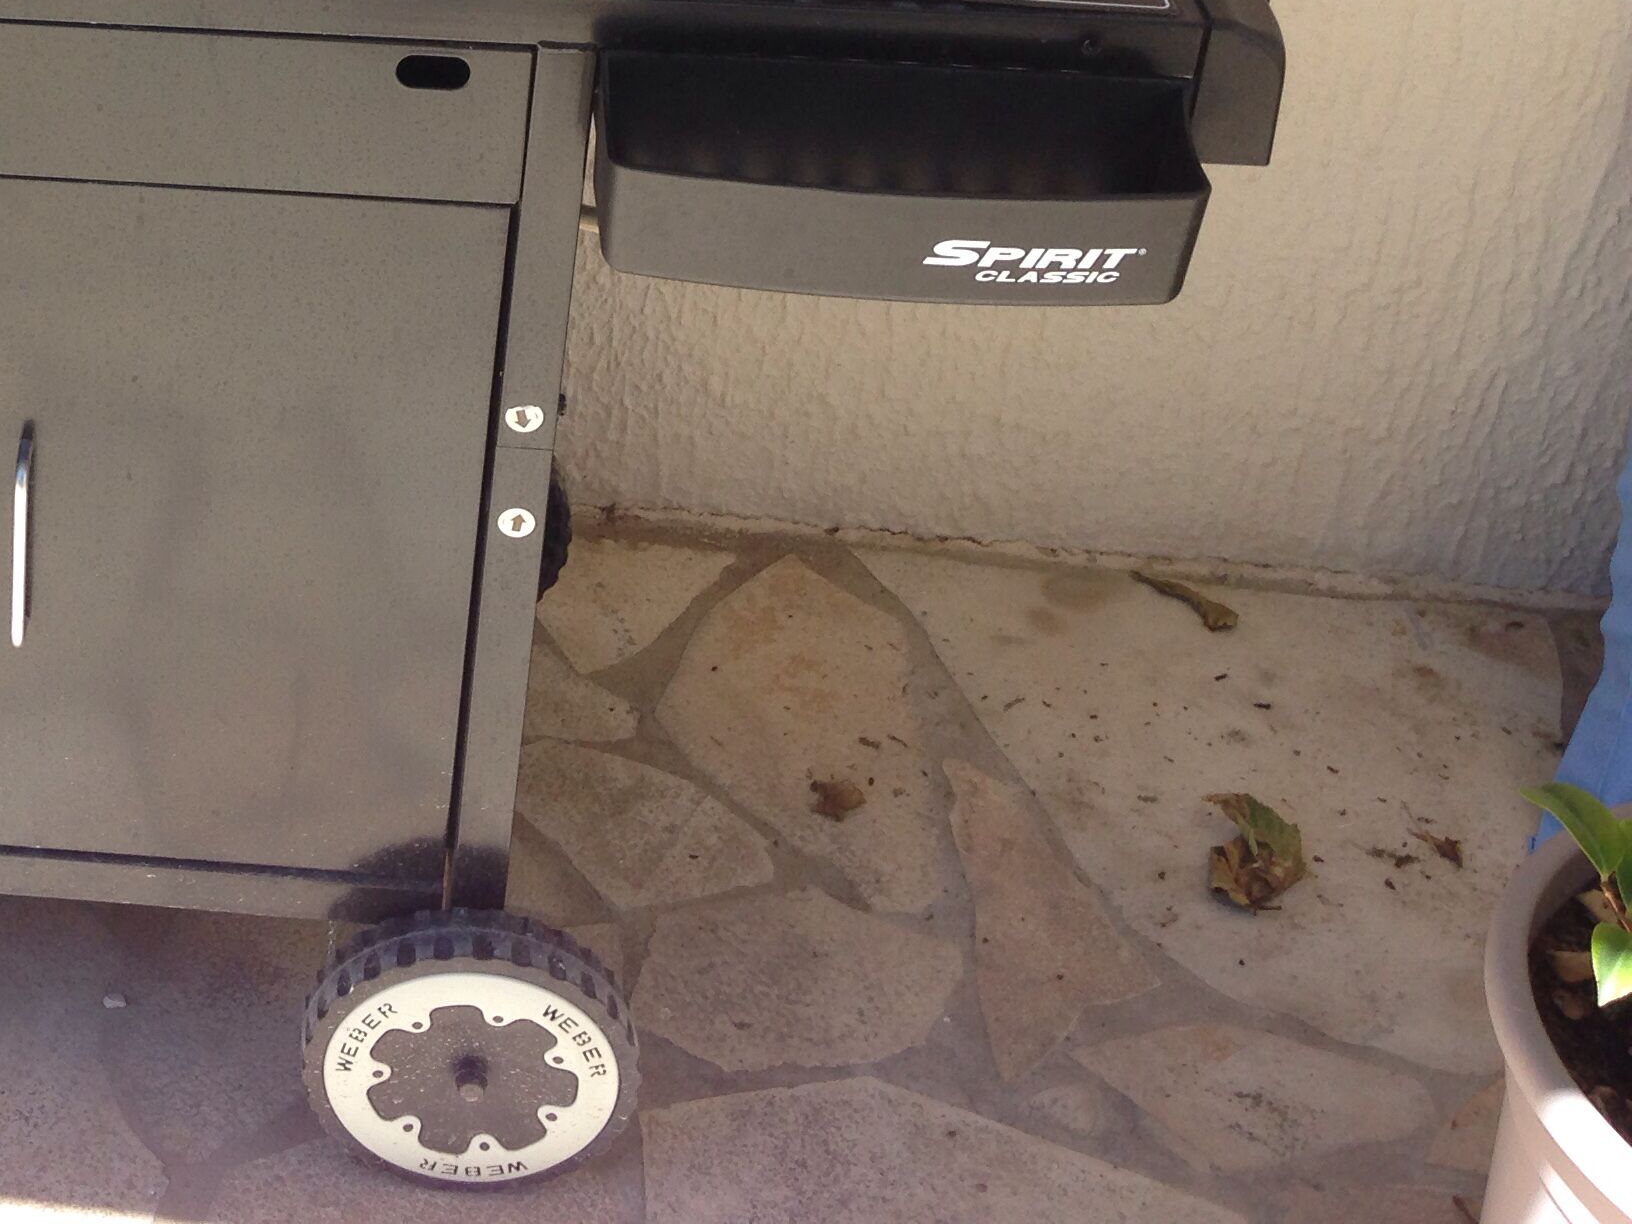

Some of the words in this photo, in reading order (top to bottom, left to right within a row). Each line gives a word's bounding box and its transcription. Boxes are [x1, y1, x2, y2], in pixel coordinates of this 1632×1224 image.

[922, 239, 1138, 269] SPIRIT
[974, 270, 1121, 284] CLASSIC
[335, 1002, 398, 1073] WEBER
[541, 1003, 608, 1078] WEBER
[418, 1158, 529, 1176] WEBER
